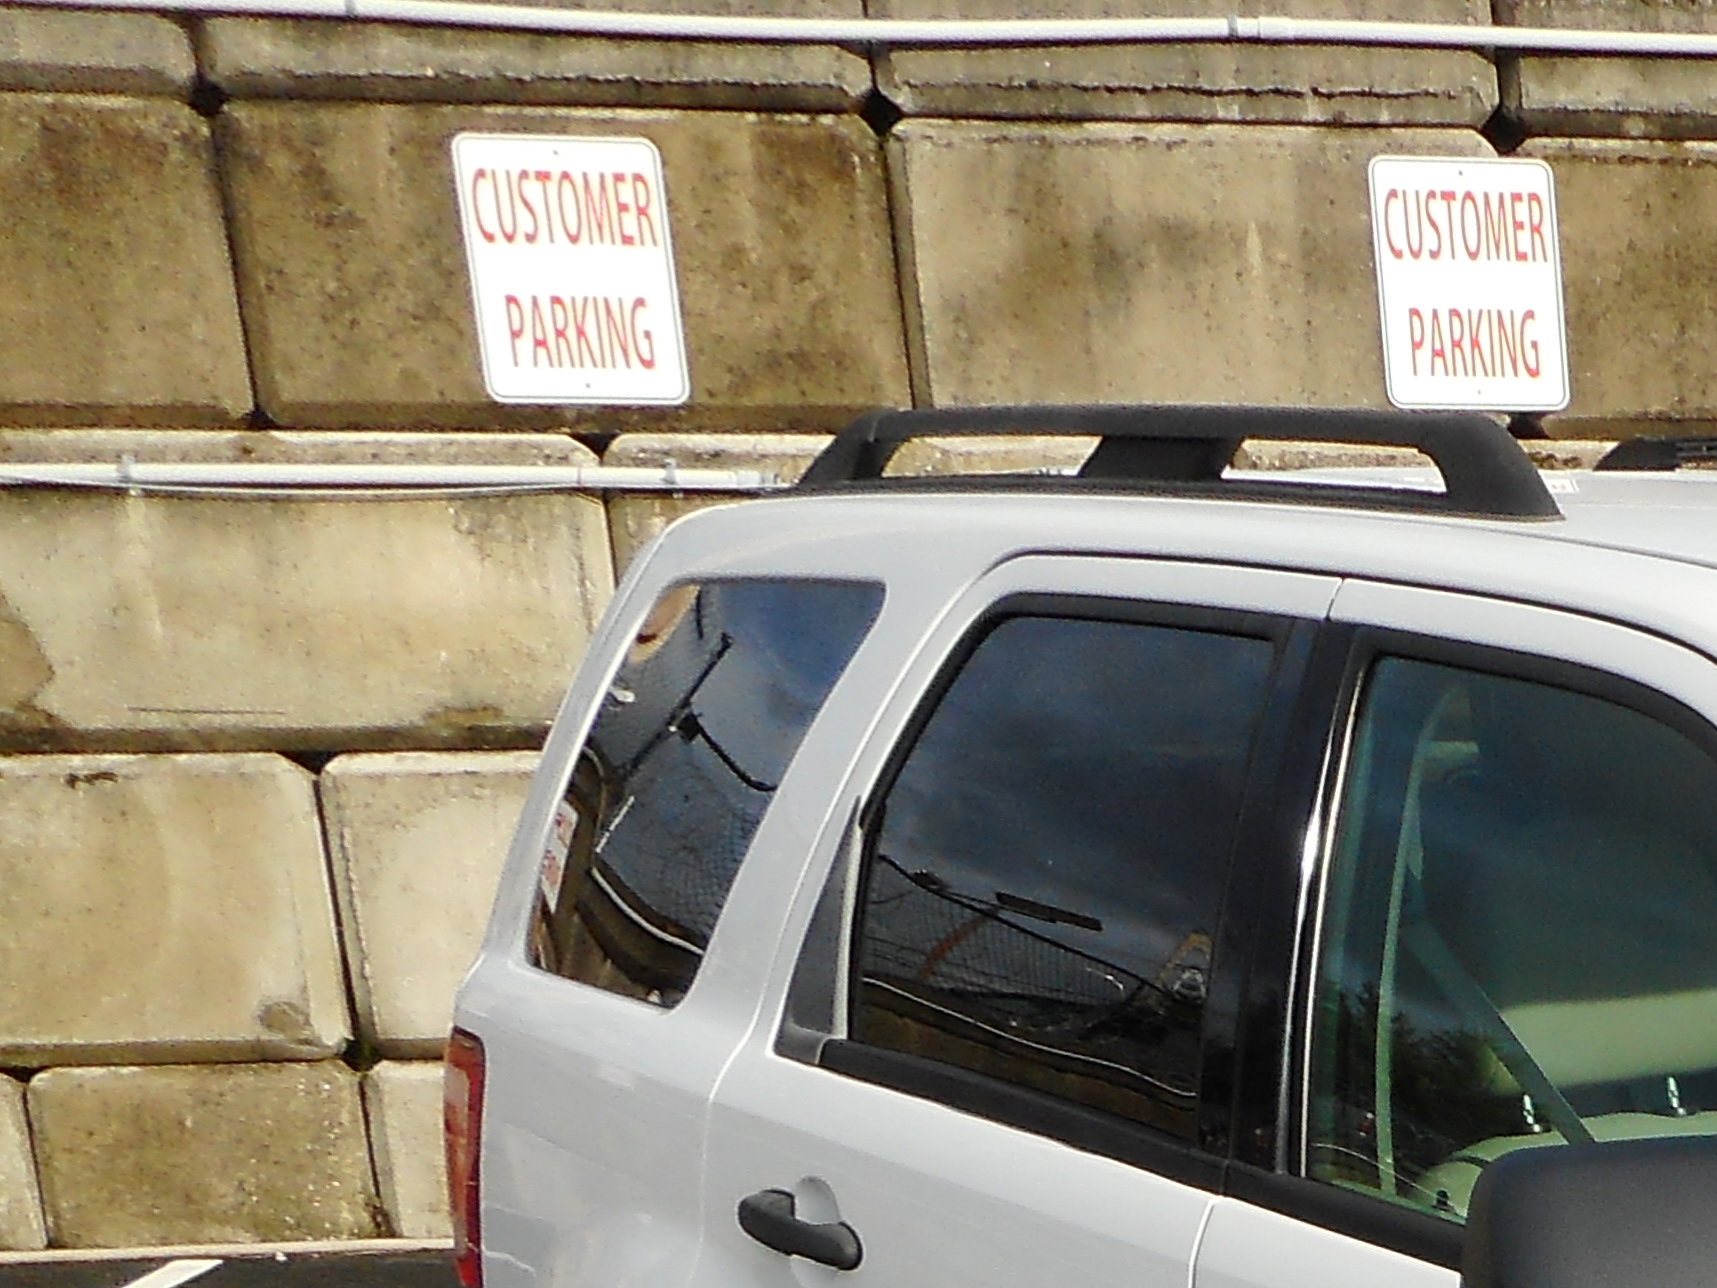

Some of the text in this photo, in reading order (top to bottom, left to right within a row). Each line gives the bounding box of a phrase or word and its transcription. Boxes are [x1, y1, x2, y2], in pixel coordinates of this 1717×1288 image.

[471, 167, 658, 249] CUSTOMER
[1385, 189, 1548, 264] CUSTOMER
[504, 294, 656, 371] PARKING
[1408, 307, 1542, 380] PARKING
